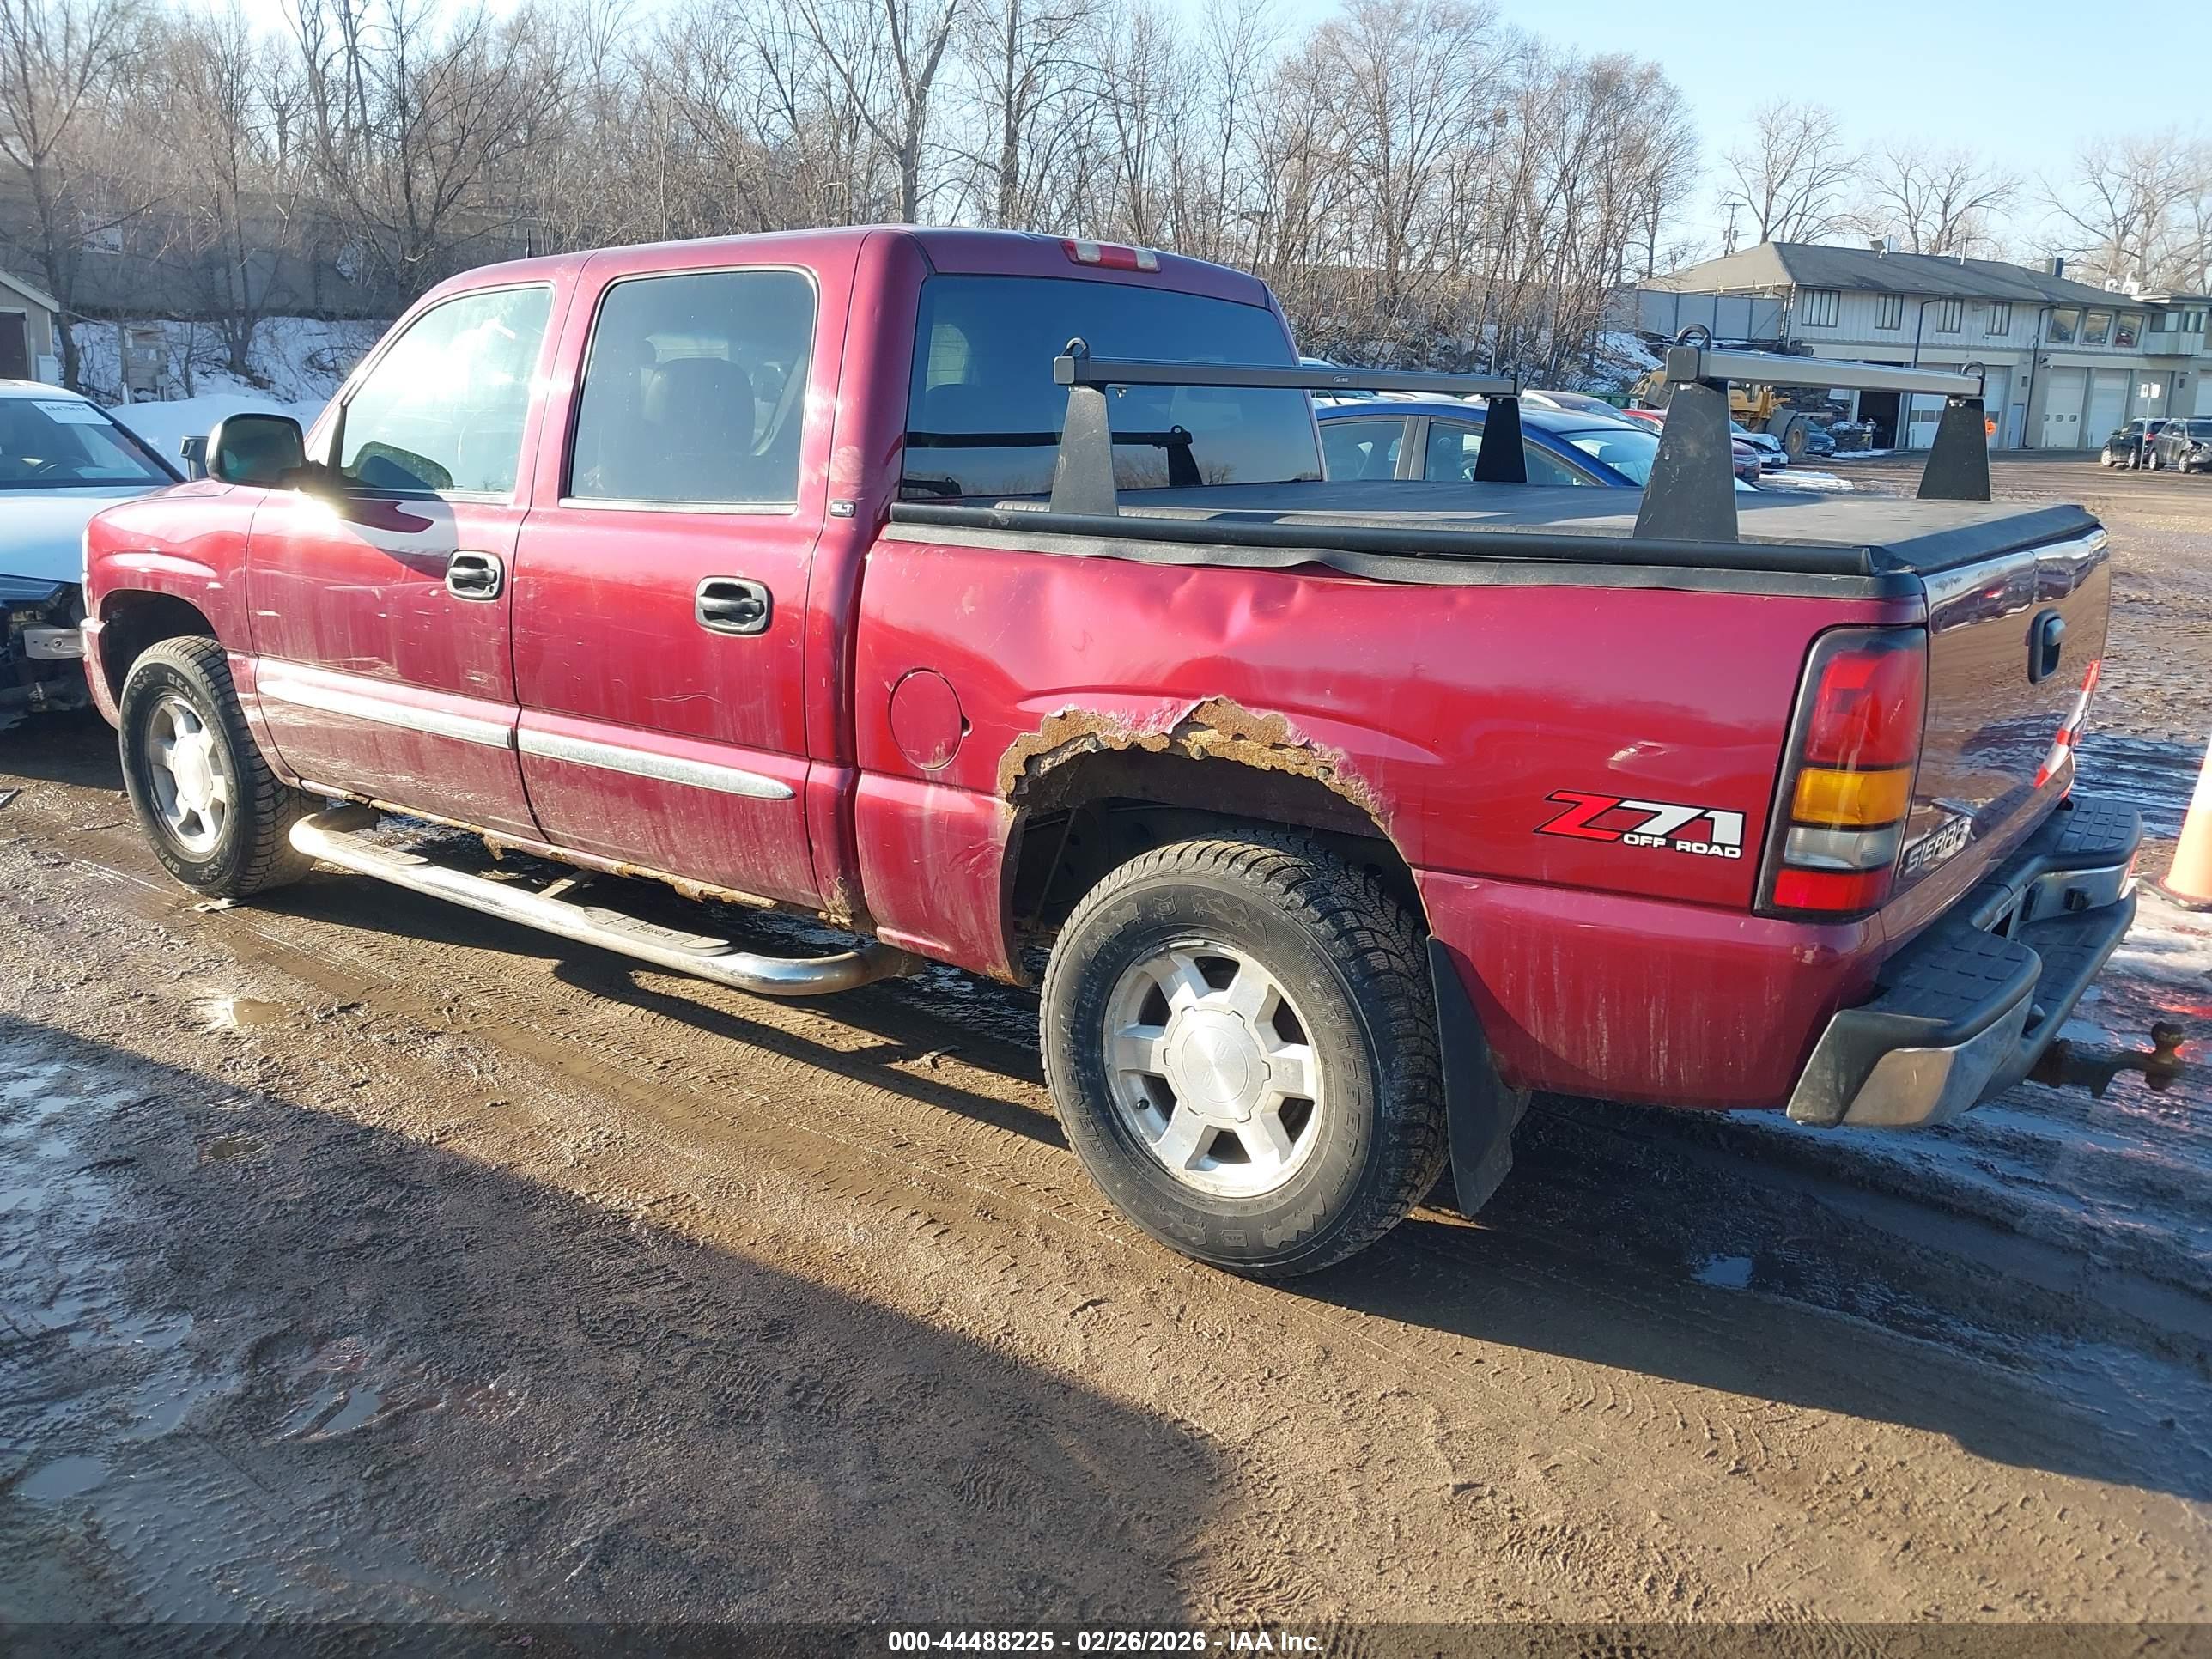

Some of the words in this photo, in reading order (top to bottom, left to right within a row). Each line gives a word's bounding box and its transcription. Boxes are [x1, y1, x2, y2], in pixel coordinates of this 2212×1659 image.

[1534, 790, 1746, 846] Z71
[1622, 833, 1666, 848] OFF
[1675, 840, 1741, 859] ROAD
[1060, 996, 1111, 1159] GENERAL
[1306, 980, 1361, 1158] GRABBER
